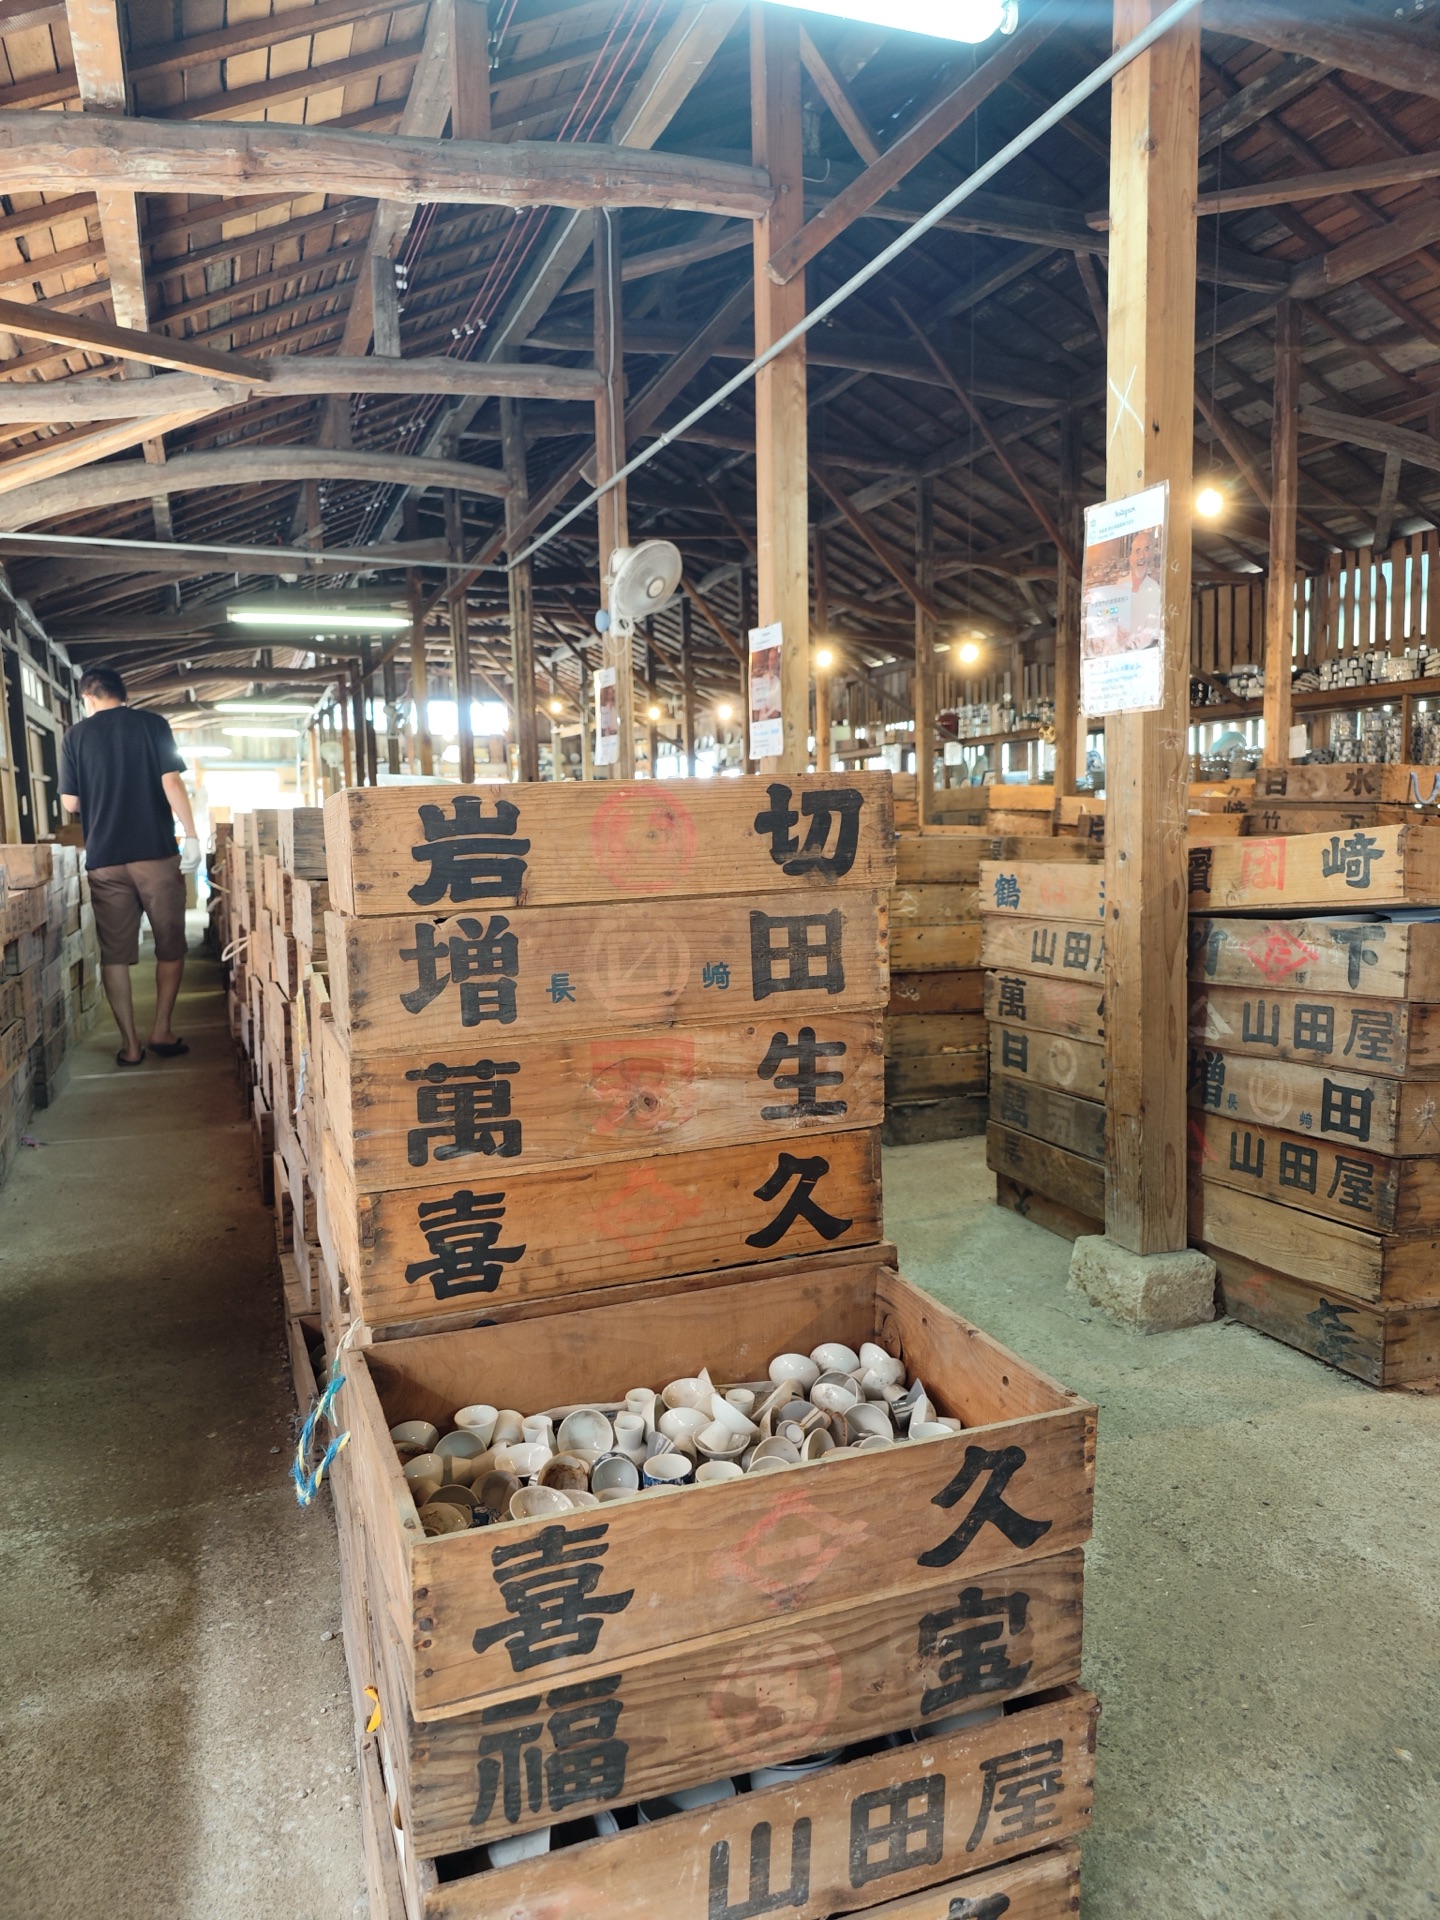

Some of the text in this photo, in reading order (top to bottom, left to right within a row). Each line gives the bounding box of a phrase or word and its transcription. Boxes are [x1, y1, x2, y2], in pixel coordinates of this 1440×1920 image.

[1343, 767, 1375, 796] 水
[407, 795, 531, 906] 岩
[754, 783, 865, 879] 切
[1262, 811, 1281, 830] 竹
[993, 874, 1022, 910] 鶴
[399, 915, 520, 1028] 増
[545, 972, 577, 1004] 長
[750, 908, 842, 1001] 田
[1031, 928, 1105, 974] 山田
[1329, 924, 1387, 990] 下
[999, 975, 1028, 1022] 萬
[1242, 999, 1394, 1063] 山田屋
[1002, 1029, 1030, 1073] 日
[405, 1058, 523, 1167] 萬
[757, 1026, 849, 1121] 生
[1321, 1077, 1375, 1142] 田
[1229, 1131, 1375, 1213] 山田屋
[404, 1152, 853, 1301] 喜 久
[472, 1444, 1053, 1673] 喜 久
[468, 1674, 630, 1825] 福
[917, 1586, 1034, 1716] 宝
[707, 1737, 1067, 1920] 山田屋
